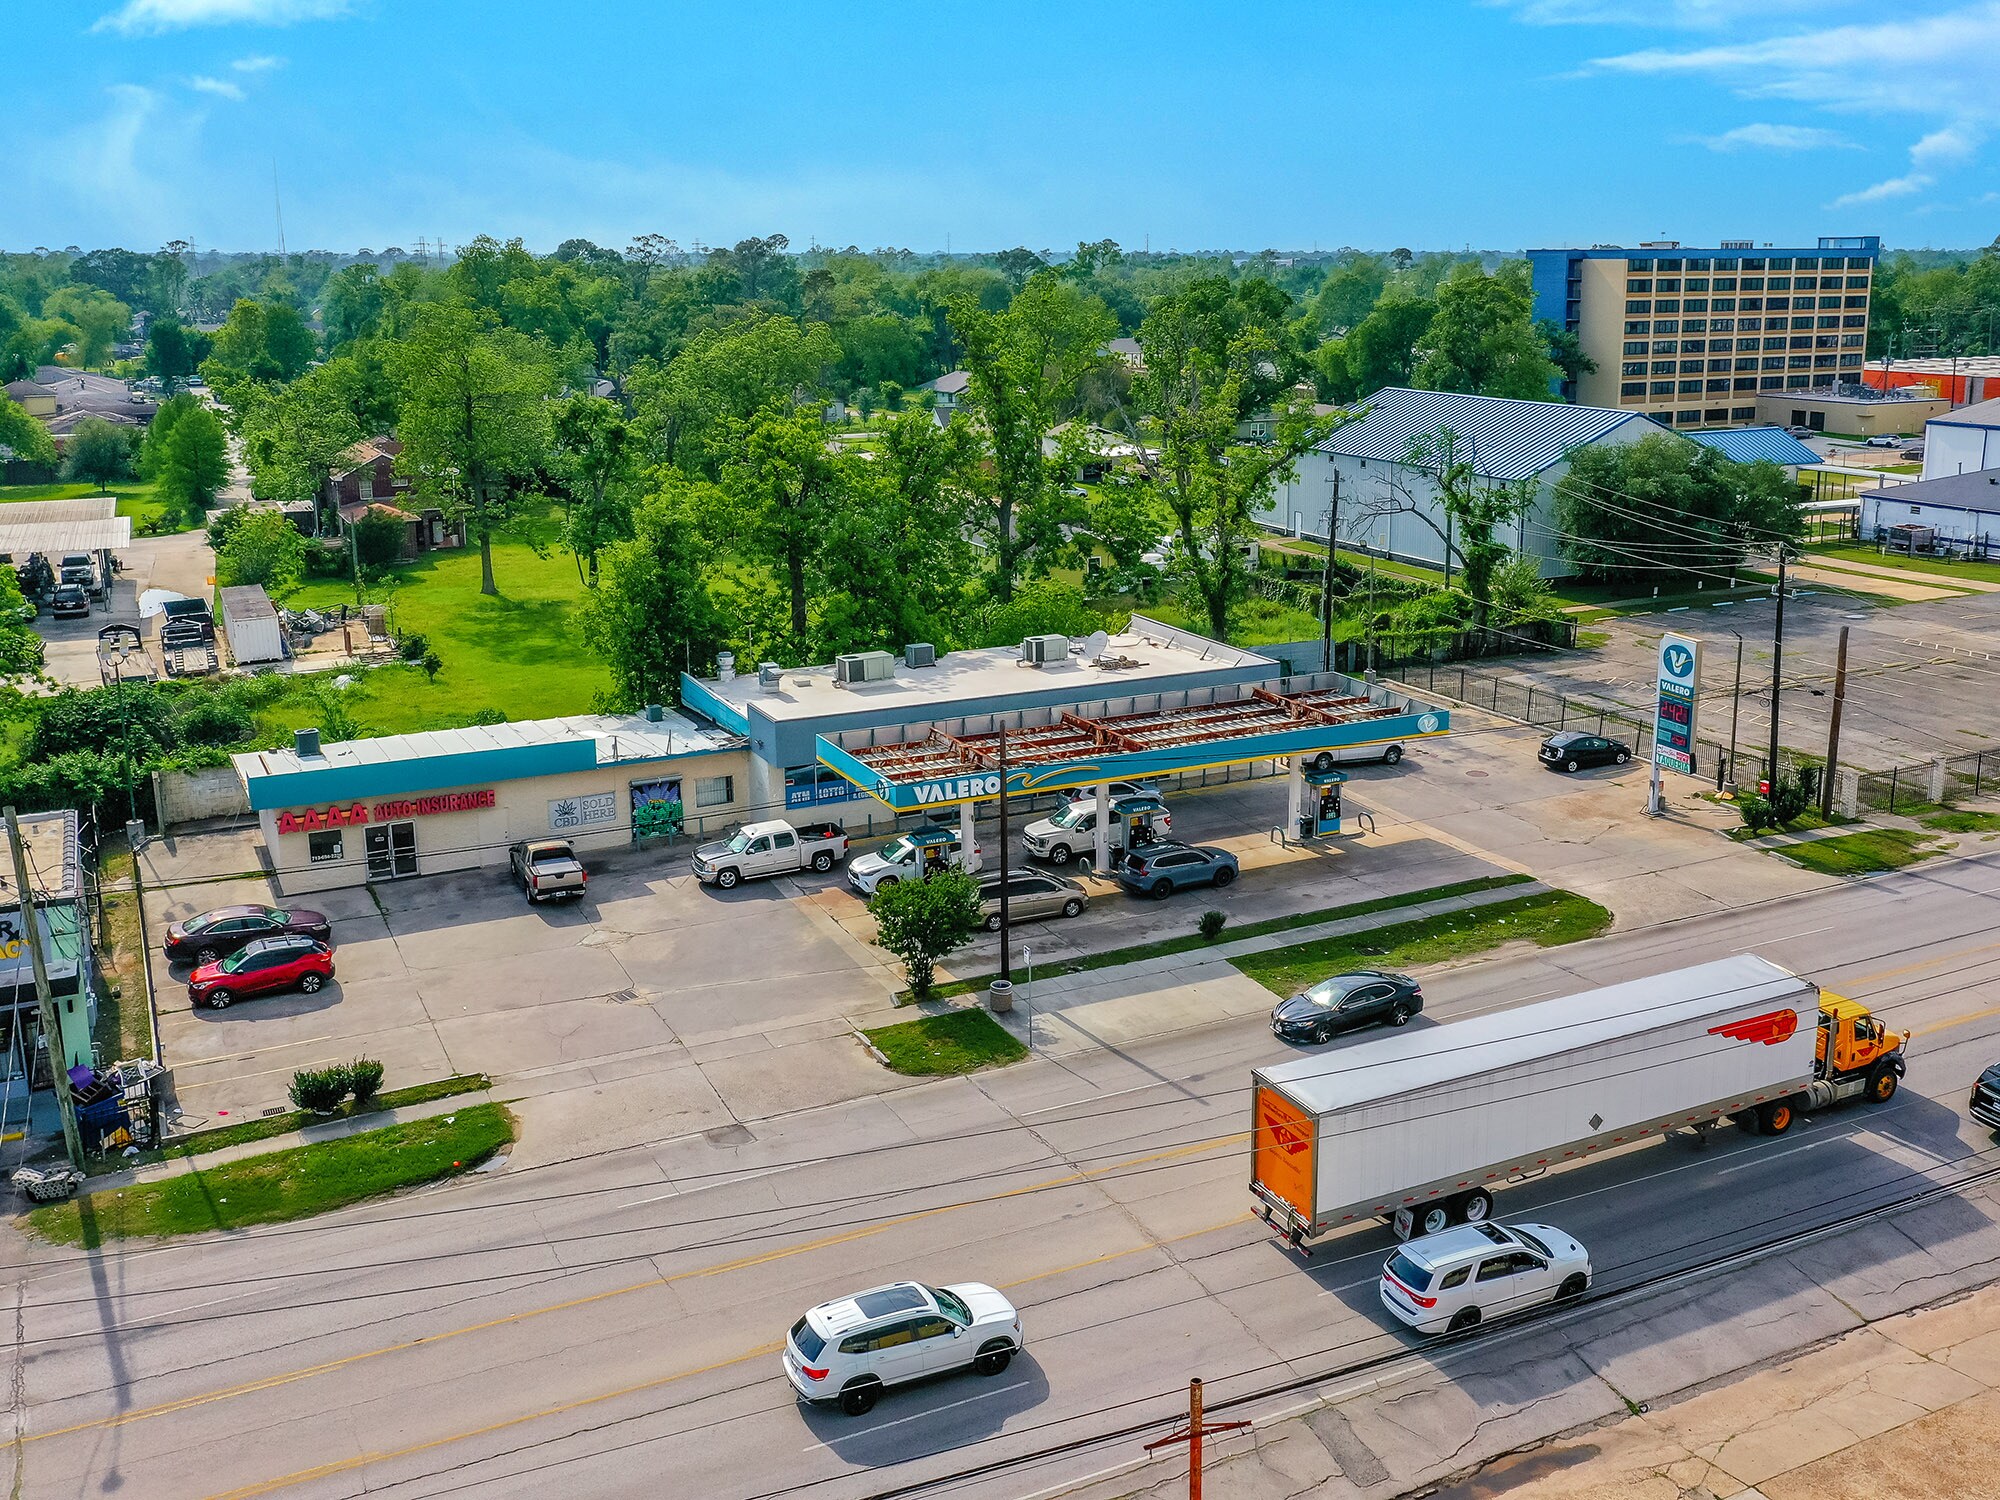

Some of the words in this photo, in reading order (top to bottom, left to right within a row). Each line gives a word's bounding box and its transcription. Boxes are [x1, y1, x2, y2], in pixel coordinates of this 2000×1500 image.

[1661, 681, 1690, 697] VALERO
[791, 790, 810, 803] ATM
[818, 786, 844, 799] LOTTO
[913, 776, 1001, 804] VALERO
[374, 800, 412, 822] AUTO
[416, 790, 496, 816] INSURANCE
[582, 797, 614, 810] SOLD
[583, 808, 616, 821] HERE
[554, 816, 580, 828] CBD
